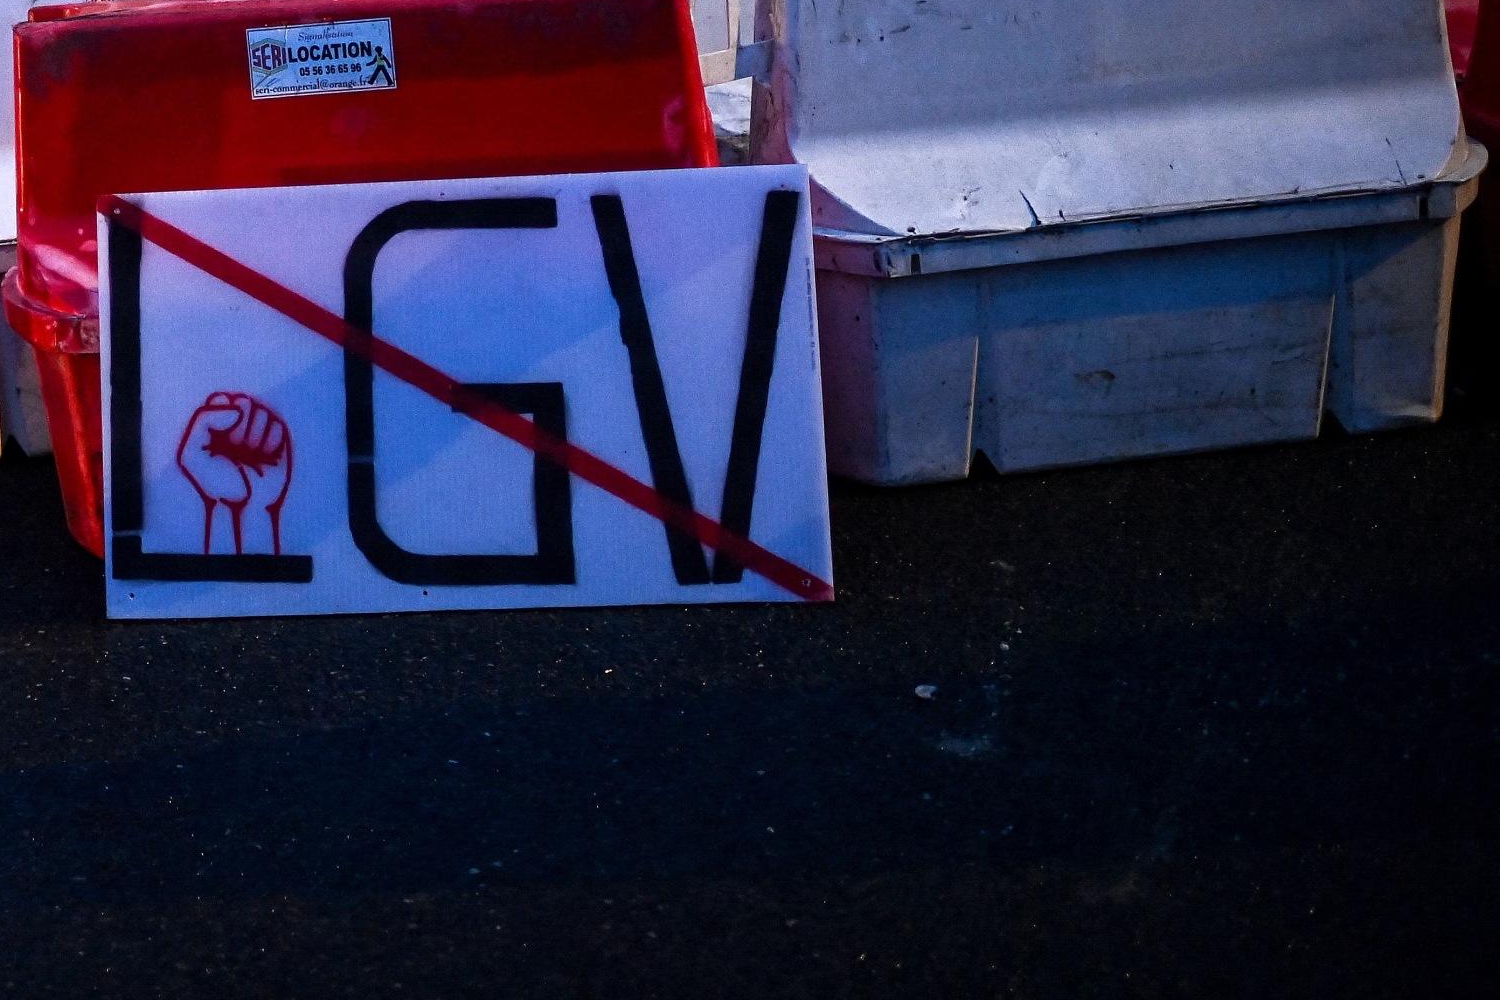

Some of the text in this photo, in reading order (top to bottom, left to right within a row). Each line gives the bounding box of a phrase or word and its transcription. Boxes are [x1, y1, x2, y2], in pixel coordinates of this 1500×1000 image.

[299, 62, 362, 77] 05 56 36 65 96
[109, 190, 800, 585] LGV
